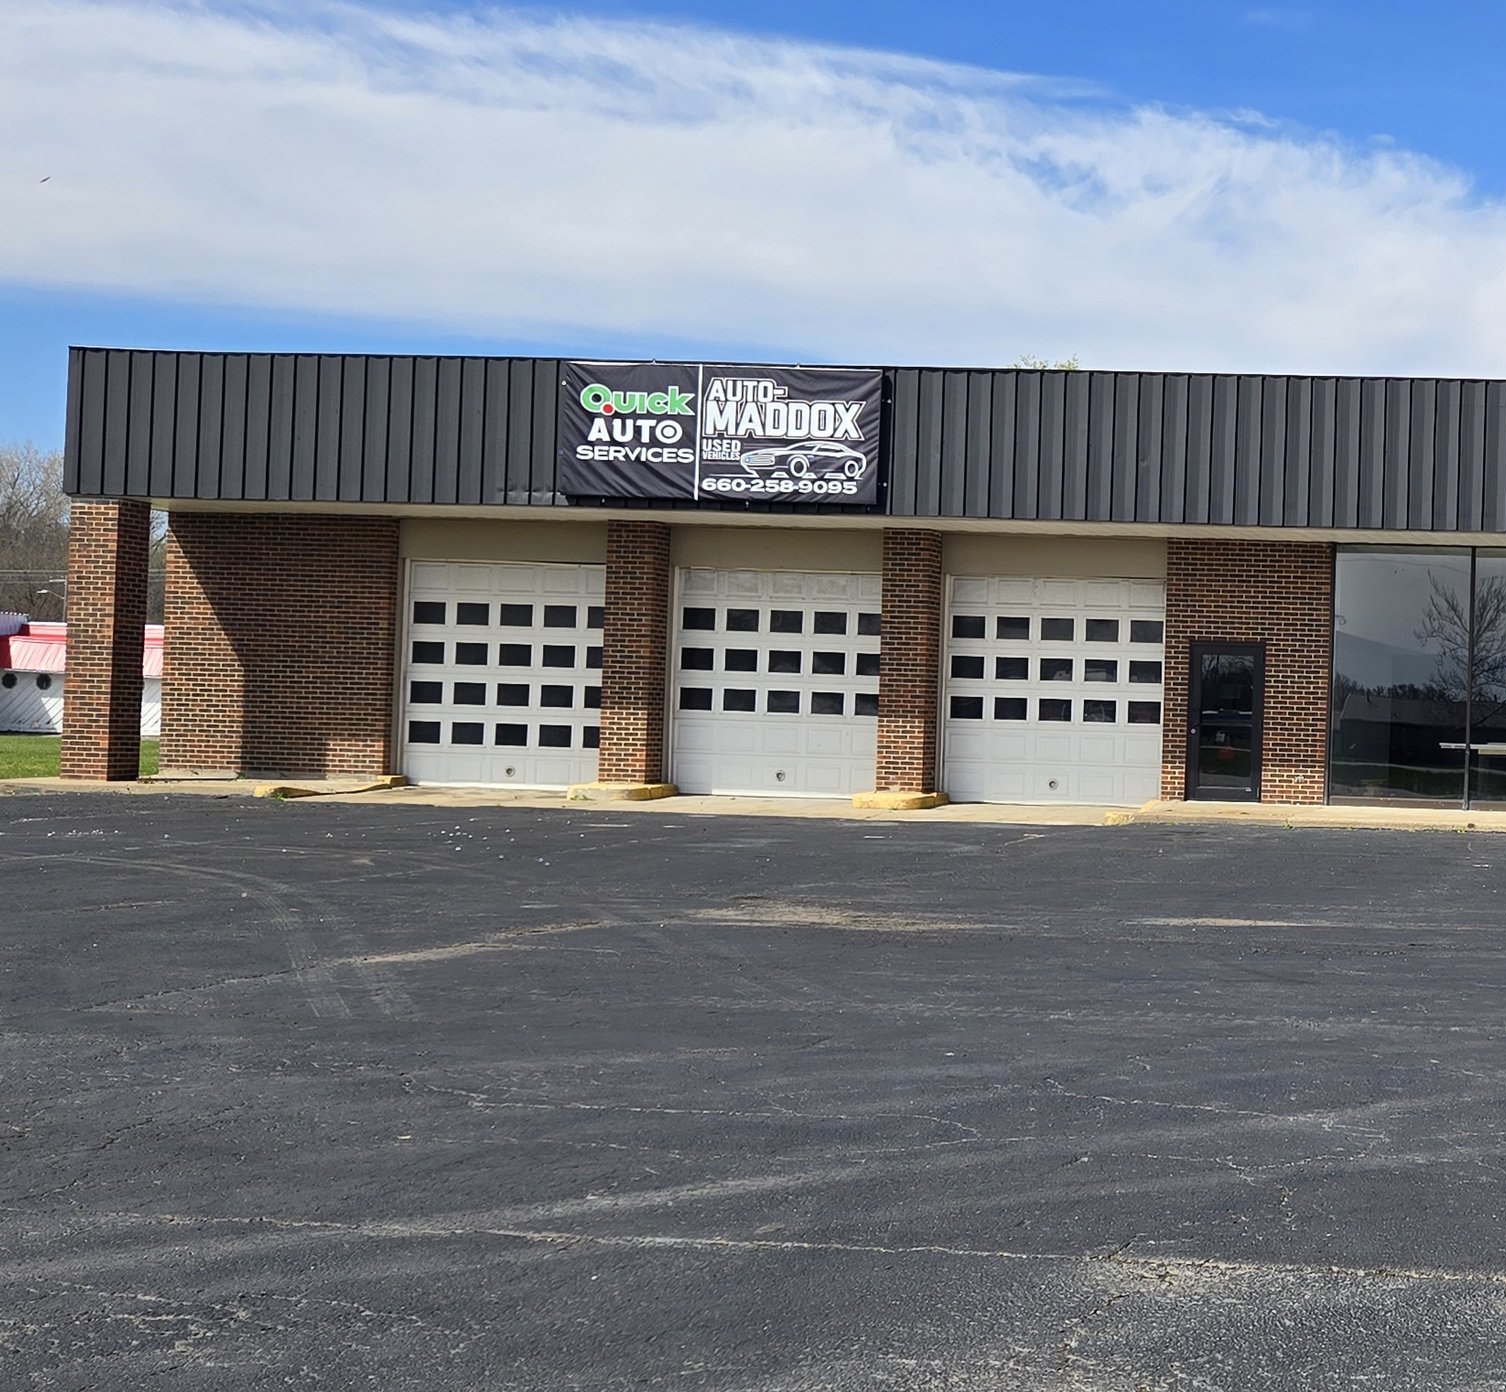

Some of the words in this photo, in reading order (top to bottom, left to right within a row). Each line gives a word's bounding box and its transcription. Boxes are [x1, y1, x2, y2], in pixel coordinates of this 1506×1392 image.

[702, 400, 867, 441] MADDOX
[587, 417, 683, 444] AUTO
[576, 444, 695, 464] SERVICES
[702, 439, 741, 452] USED
[702, 450, 741, 461] VEHICLES
[701, 477, 858, 495] 660-258-9095
